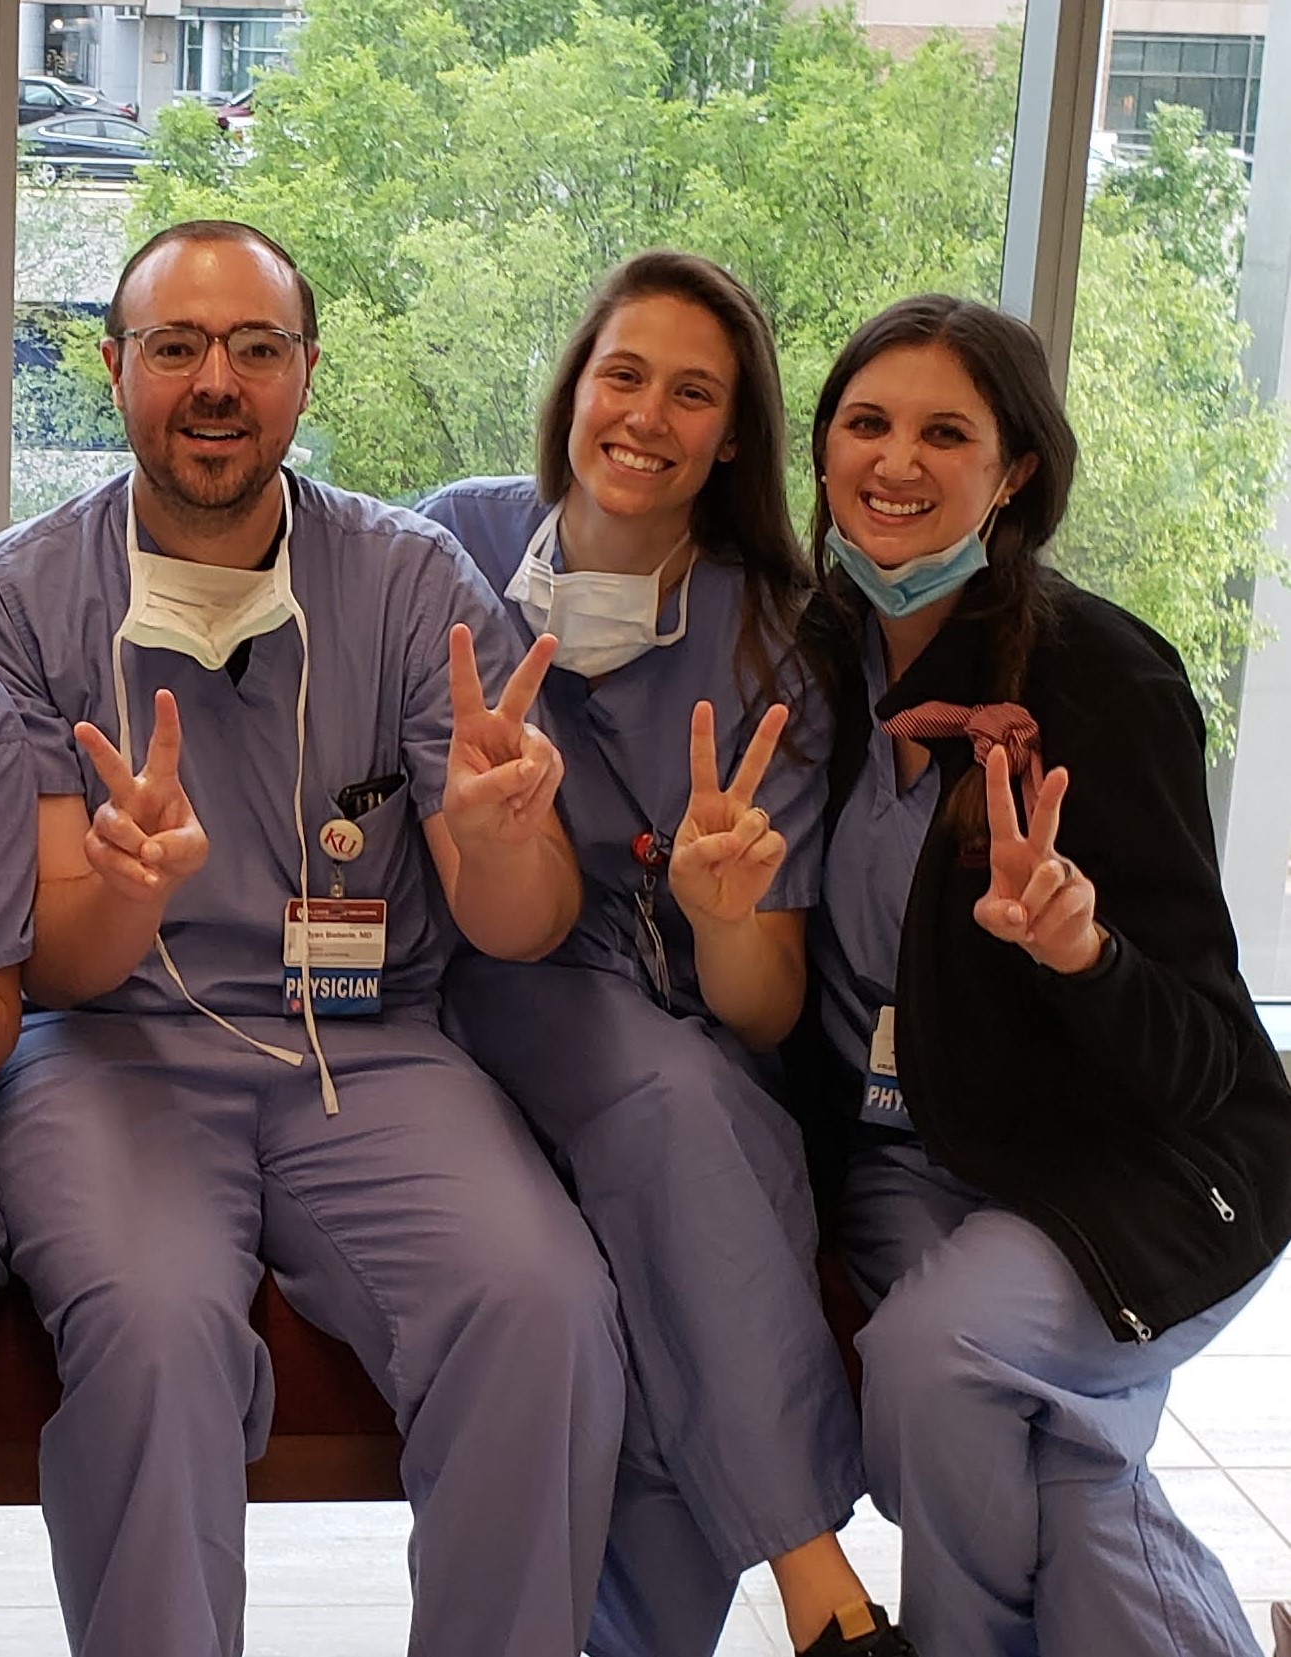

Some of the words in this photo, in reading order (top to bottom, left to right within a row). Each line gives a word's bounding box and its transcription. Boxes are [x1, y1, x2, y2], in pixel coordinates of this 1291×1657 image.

[324, 827, 358, 858] KU
[286, 977, 378, 999] PHYSICIAN
[867, 1084, 908, 1113] PHY
